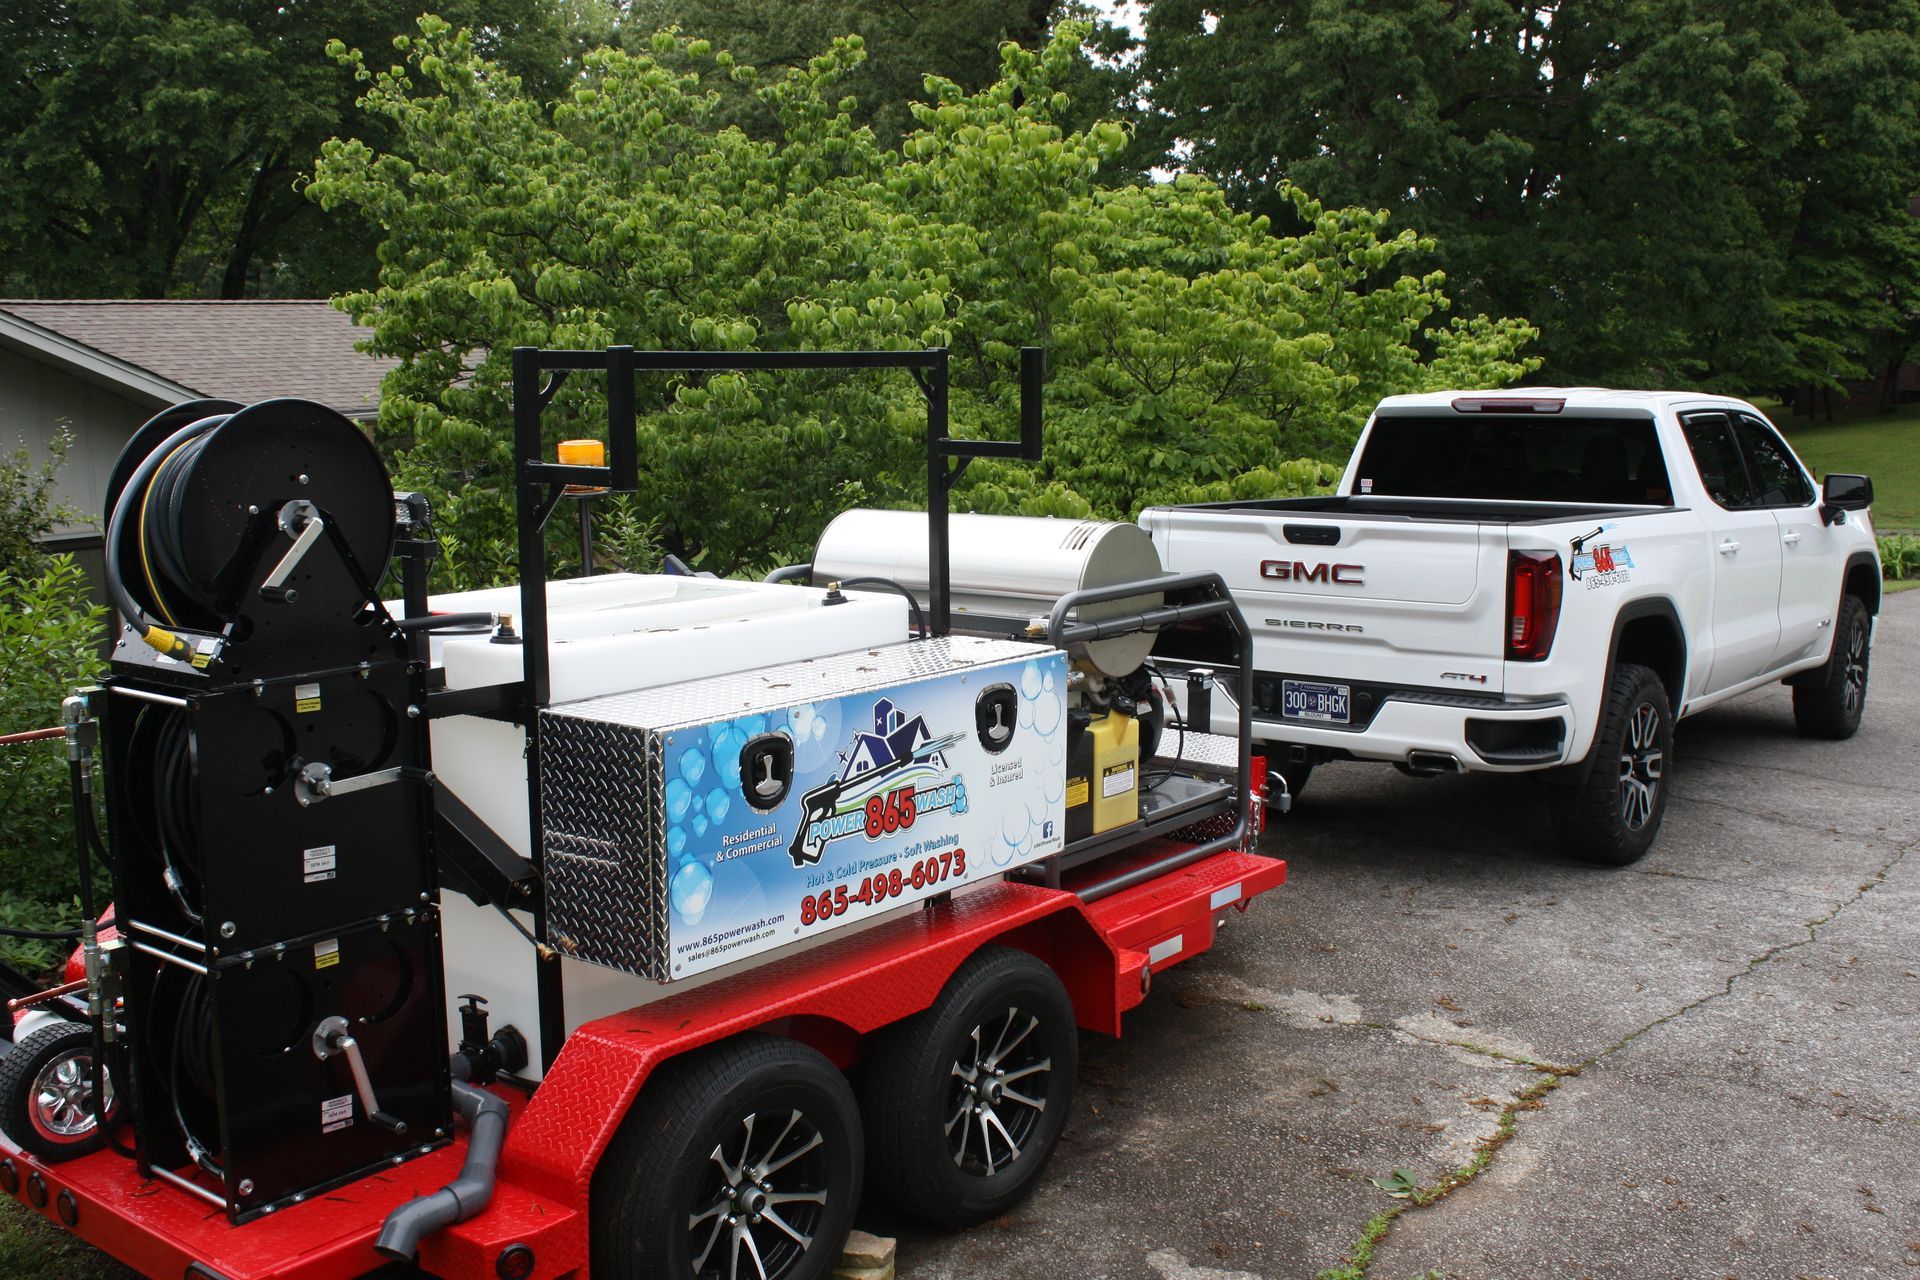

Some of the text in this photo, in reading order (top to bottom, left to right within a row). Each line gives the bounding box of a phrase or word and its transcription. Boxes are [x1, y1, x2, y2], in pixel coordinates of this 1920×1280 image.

[1260, 560, 1365, 585] GMC
[1265, 618, 1363, 633] SIERRA
[1440, 672, 1487, 684] AT4
[1286, 691, 1346, 713] 300 BHGK
[991, 755, 1022, 775] Licensed
[997, 768, 1023, 785] Insured
[808, 784, 956, 843] POWER 865 WASH
[722, 822, 776, 847] Residential
[716, 834, 783, 862] & Commercial
[806, 833, 959, 888] Hot & Cold Pressure Soft Washing
[801, 848, 966, 926] 865-498-6073
[677, 913, 785, 954] www.865powerwash.com
[688, 928, 776, 962] sales@865powerwash.com
